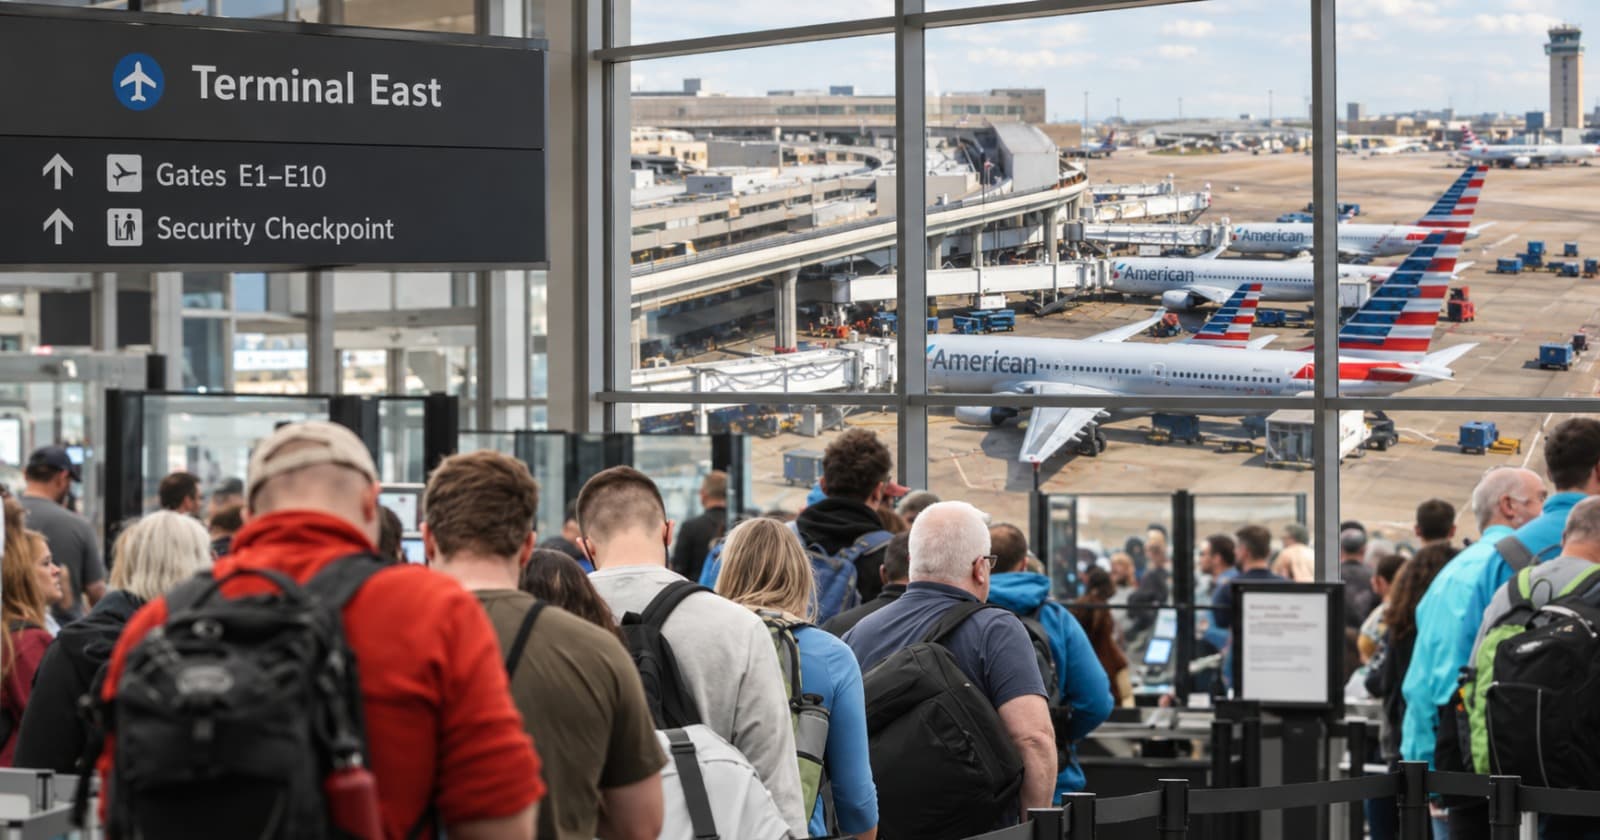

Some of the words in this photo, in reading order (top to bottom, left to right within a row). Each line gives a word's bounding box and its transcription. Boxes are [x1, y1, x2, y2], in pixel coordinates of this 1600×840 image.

[192, 65, 354, 105] Terminal
[370, 73, 442, 108] East
[156, 163, 227, 188] Gates
[157, 216, 256, 246] Security
[264, 216, 395, 246] Checkpoint
[1241, 229, 1305, 243] American
[1123, 266, 1195, 283] American
[932, 348, 1037, 375] American
